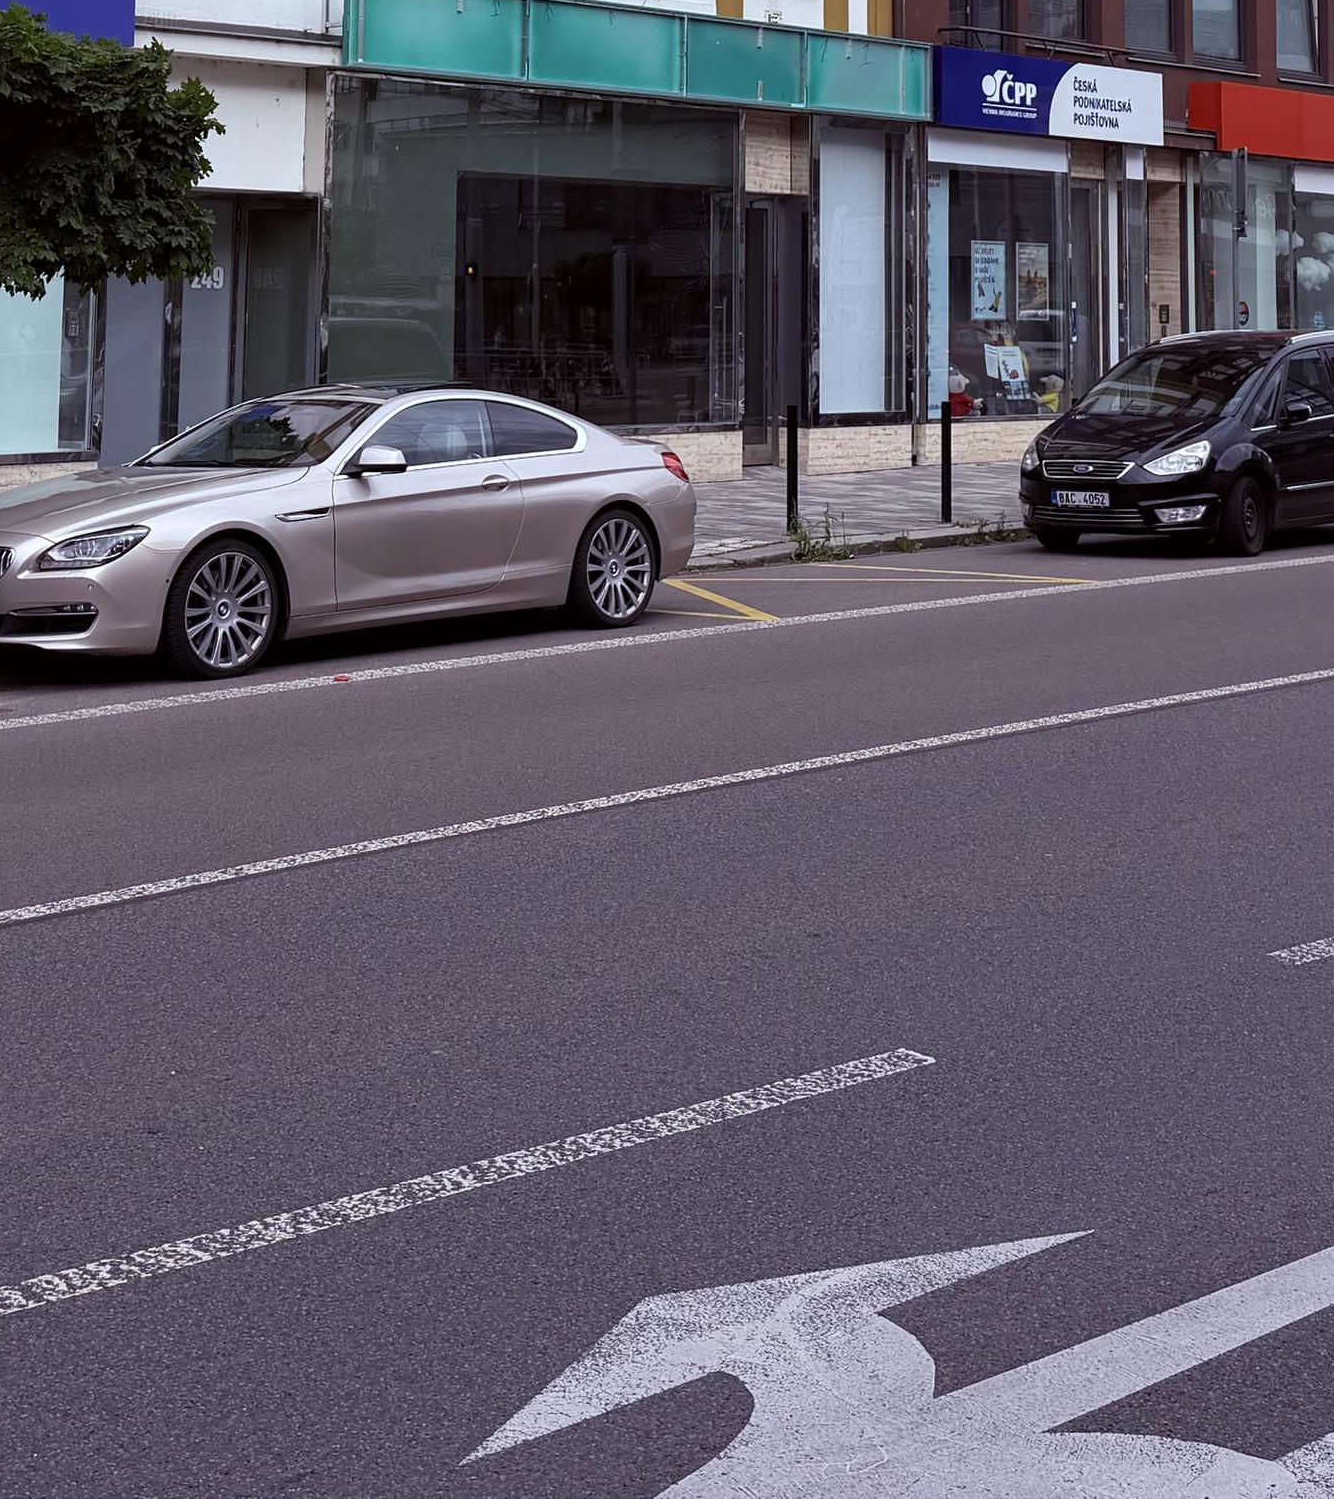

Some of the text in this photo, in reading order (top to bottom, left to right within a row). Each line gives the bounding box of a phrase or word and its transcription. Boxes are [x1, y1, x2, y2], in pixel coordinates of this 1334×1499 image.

[1002, 73, 1037, 106] ČPP
[1073, 76, 1098, 93] ČESKÁ
[1073, 95, 1132, 113] PODNIKATELSKÁ
[1073, 112, 1120, 129] POJIŠŤOVNA
[191, 266, 224, 289] 249
[1083, 493, 1106, 505] 4052
